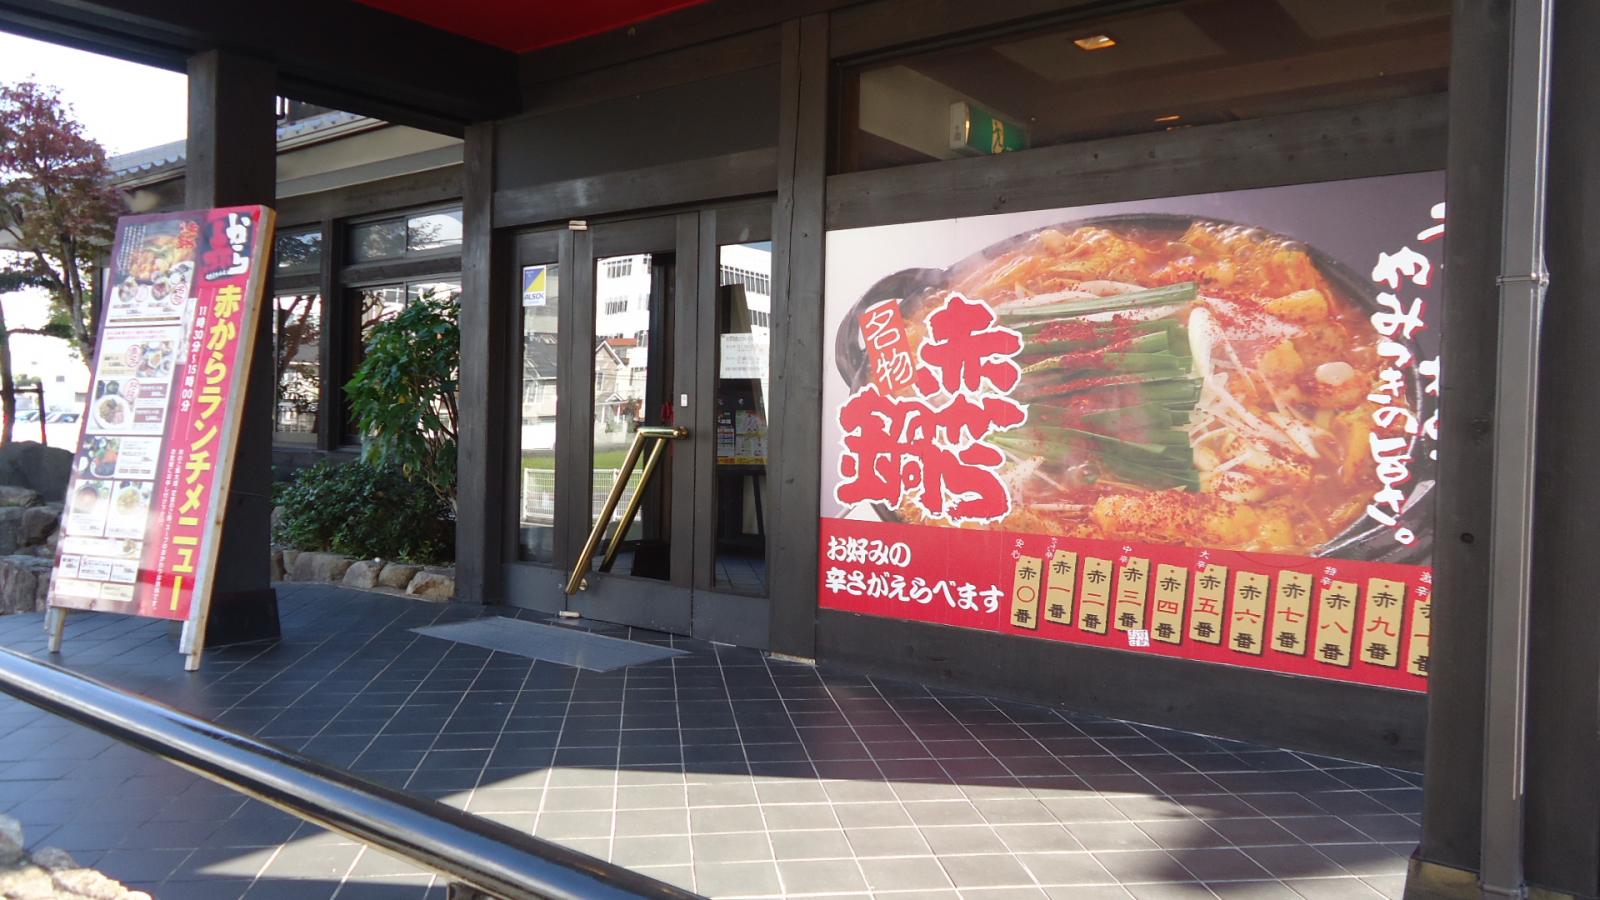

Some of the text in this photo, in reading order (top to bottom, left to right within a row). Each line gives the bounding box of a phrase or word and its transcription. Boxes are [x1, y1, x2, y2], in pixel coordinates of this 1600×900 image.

[865, 306, 914, 391] 名物
[169, 284, 242, 611] 赤からランチメニュー
[826, 536, 912, 568] お好みの
[824, 566, 1005, 615] 辛さがえらべます
[1048, 560, 1072, 619] 赤一番
[1082, 569, 1107, 629] 赤二番
[1118, 567, 1144, 628] 赤三番
[1154, 576, 1182, 639] 赤四番
[1193, 575, 1222, 639] 赤五番
[1233, 585, 1262, 650] 赤六番
[1276, 583, 1306, 649] 赤七番
[1319, 593, 1351, 662] 赤八番
[1366, 591, 1397, 661] 赤九番
